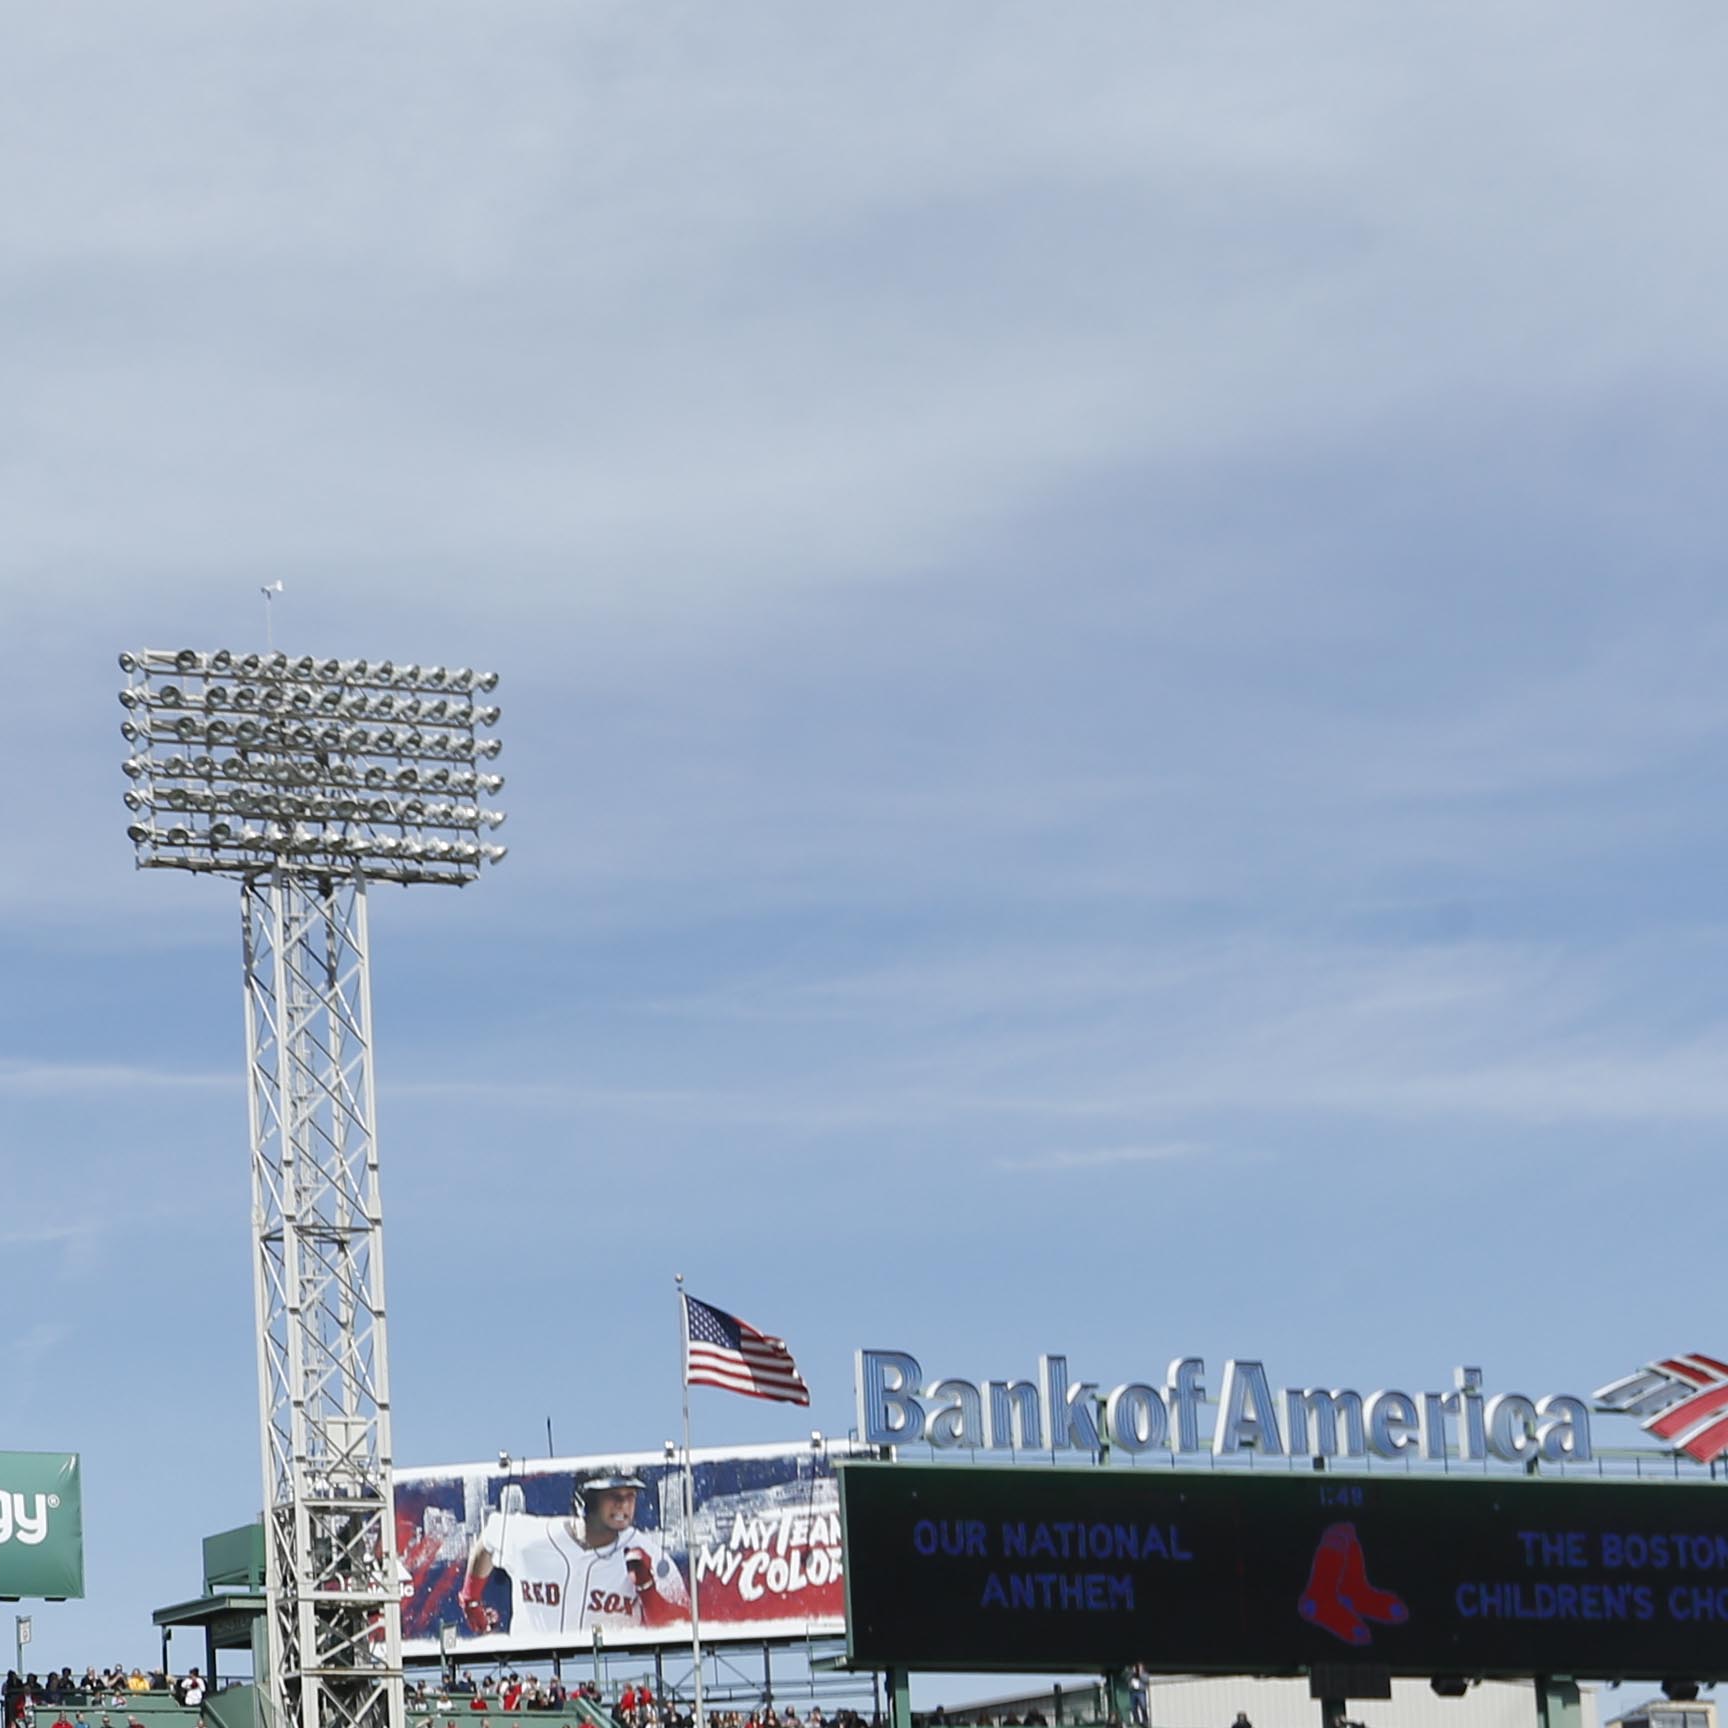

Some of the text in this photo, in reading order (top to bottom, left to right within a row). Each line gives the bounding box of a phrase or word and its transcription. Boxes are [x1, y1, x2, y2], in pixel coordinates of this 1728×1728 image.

[730, 1512, 777, 1551] MY
[912, 1519, 1195, 1561] OUR NATIONAL
[1517, 1530, 1589, 1568] THE
[697, 1543, 743, 1586] MY
[519, 1579, 561, 1607] RED
[979, 1571, 1136, 1610] ANTHEM
[1455, 1582, 1655, 1621] CHILDREN'S
